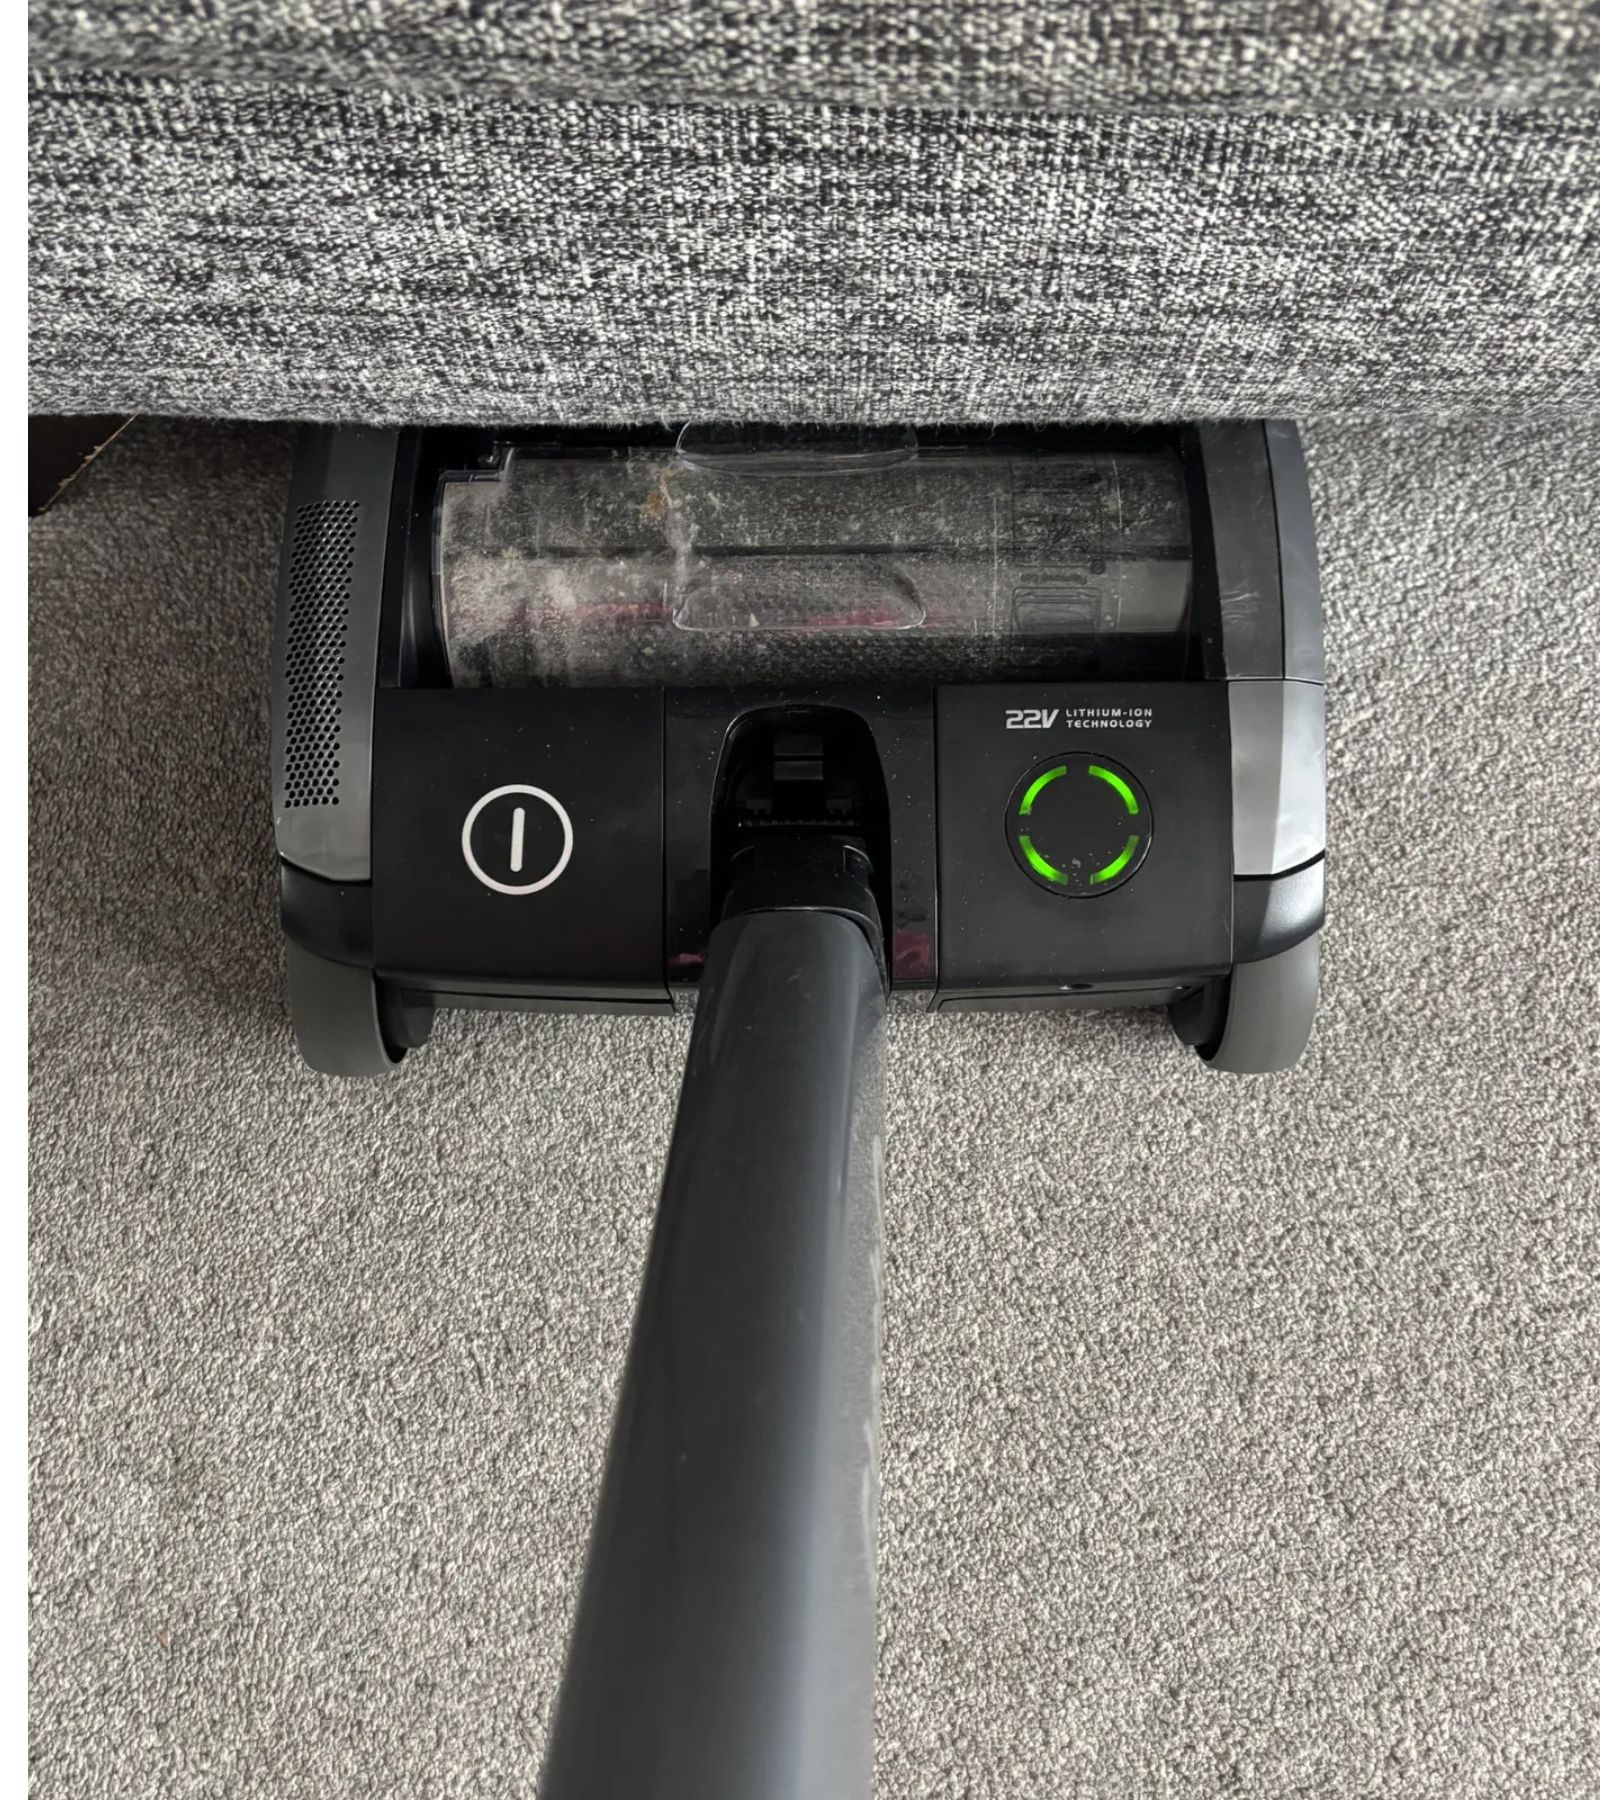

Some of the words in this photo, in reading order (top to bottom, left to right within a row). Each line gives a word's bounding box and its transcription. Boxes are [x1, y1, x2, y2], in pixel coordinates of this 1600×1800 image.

[1005, 708, 1060, 729] 22V
[1066, 708, 1153, 718] LITHIUM-ION
[1066, 719, 1153, 729] TECHNOLOGY
